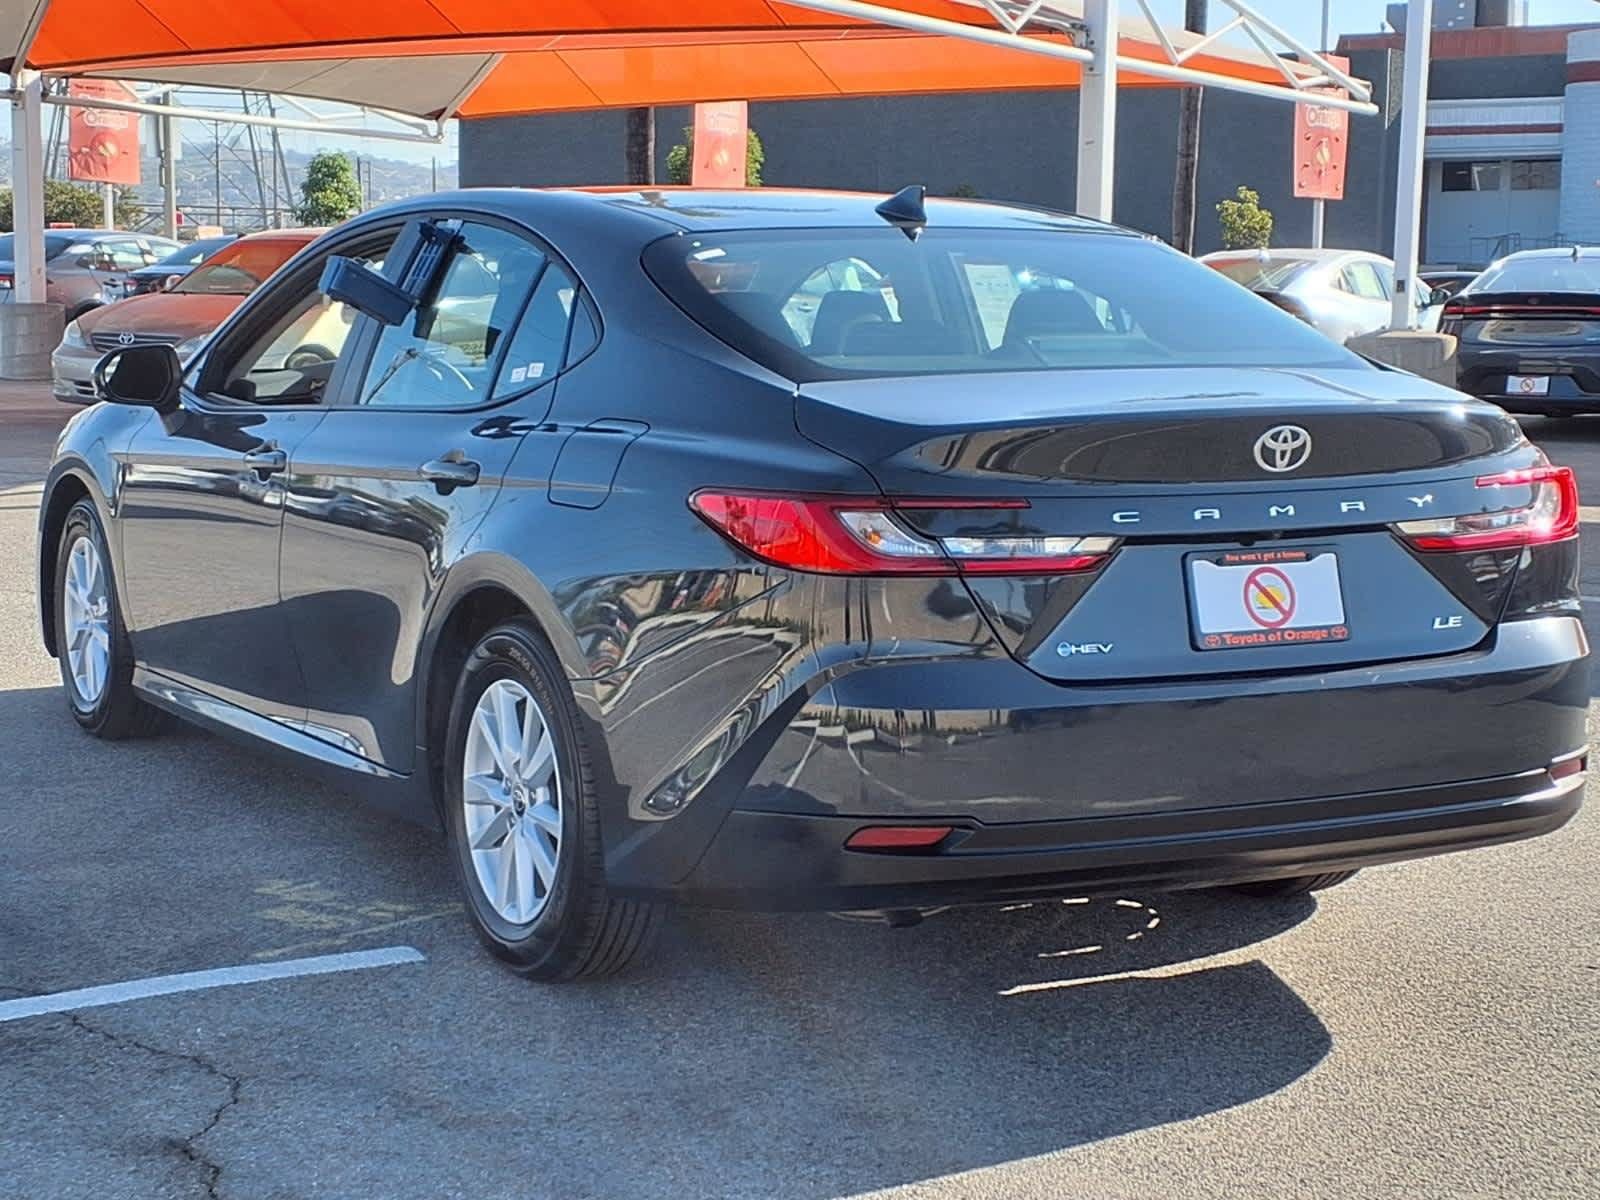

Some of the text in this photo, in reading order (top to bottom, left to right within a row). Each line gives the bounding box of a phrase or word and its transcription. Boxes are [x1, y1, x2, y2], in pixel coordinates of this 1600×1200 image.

[1112, 494, 1433, 522] CAMRY
[1432, 616, 1463, 629] LE
[1222, 629, 1328, 645] Toyota of Orange
